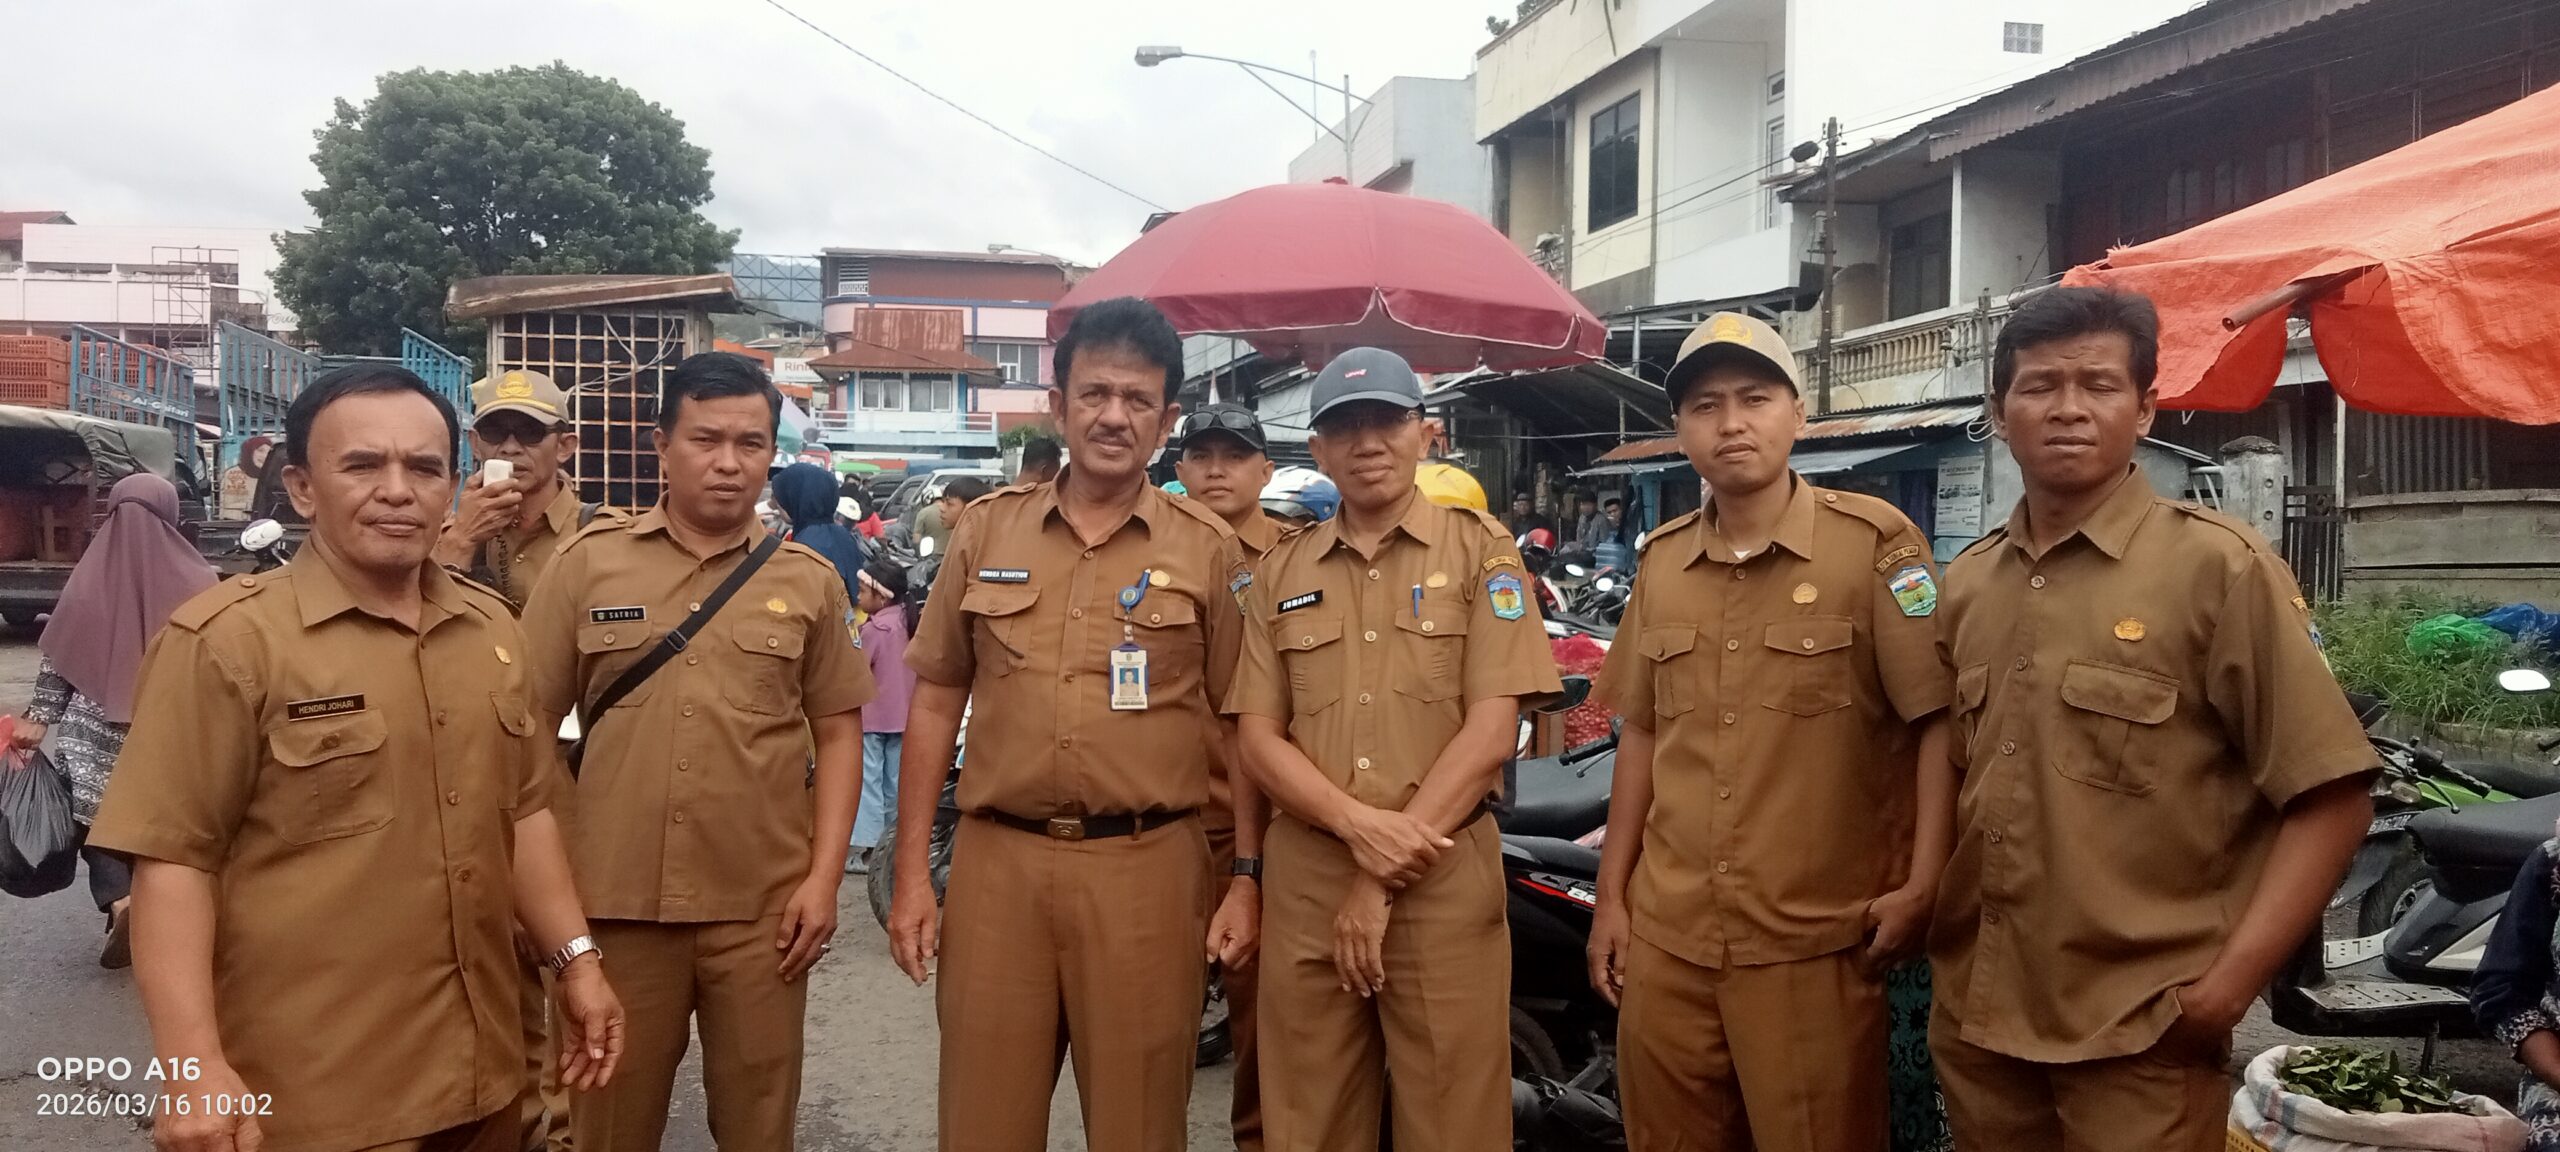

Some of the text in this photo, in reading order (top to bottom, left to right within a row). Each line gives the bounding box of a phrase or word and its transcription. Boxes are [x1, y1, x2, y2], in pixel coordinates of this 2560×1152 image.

[609, 611, 639, 619] SATRIA
[299, 700, 354, 714] HENDRI JOHARI
